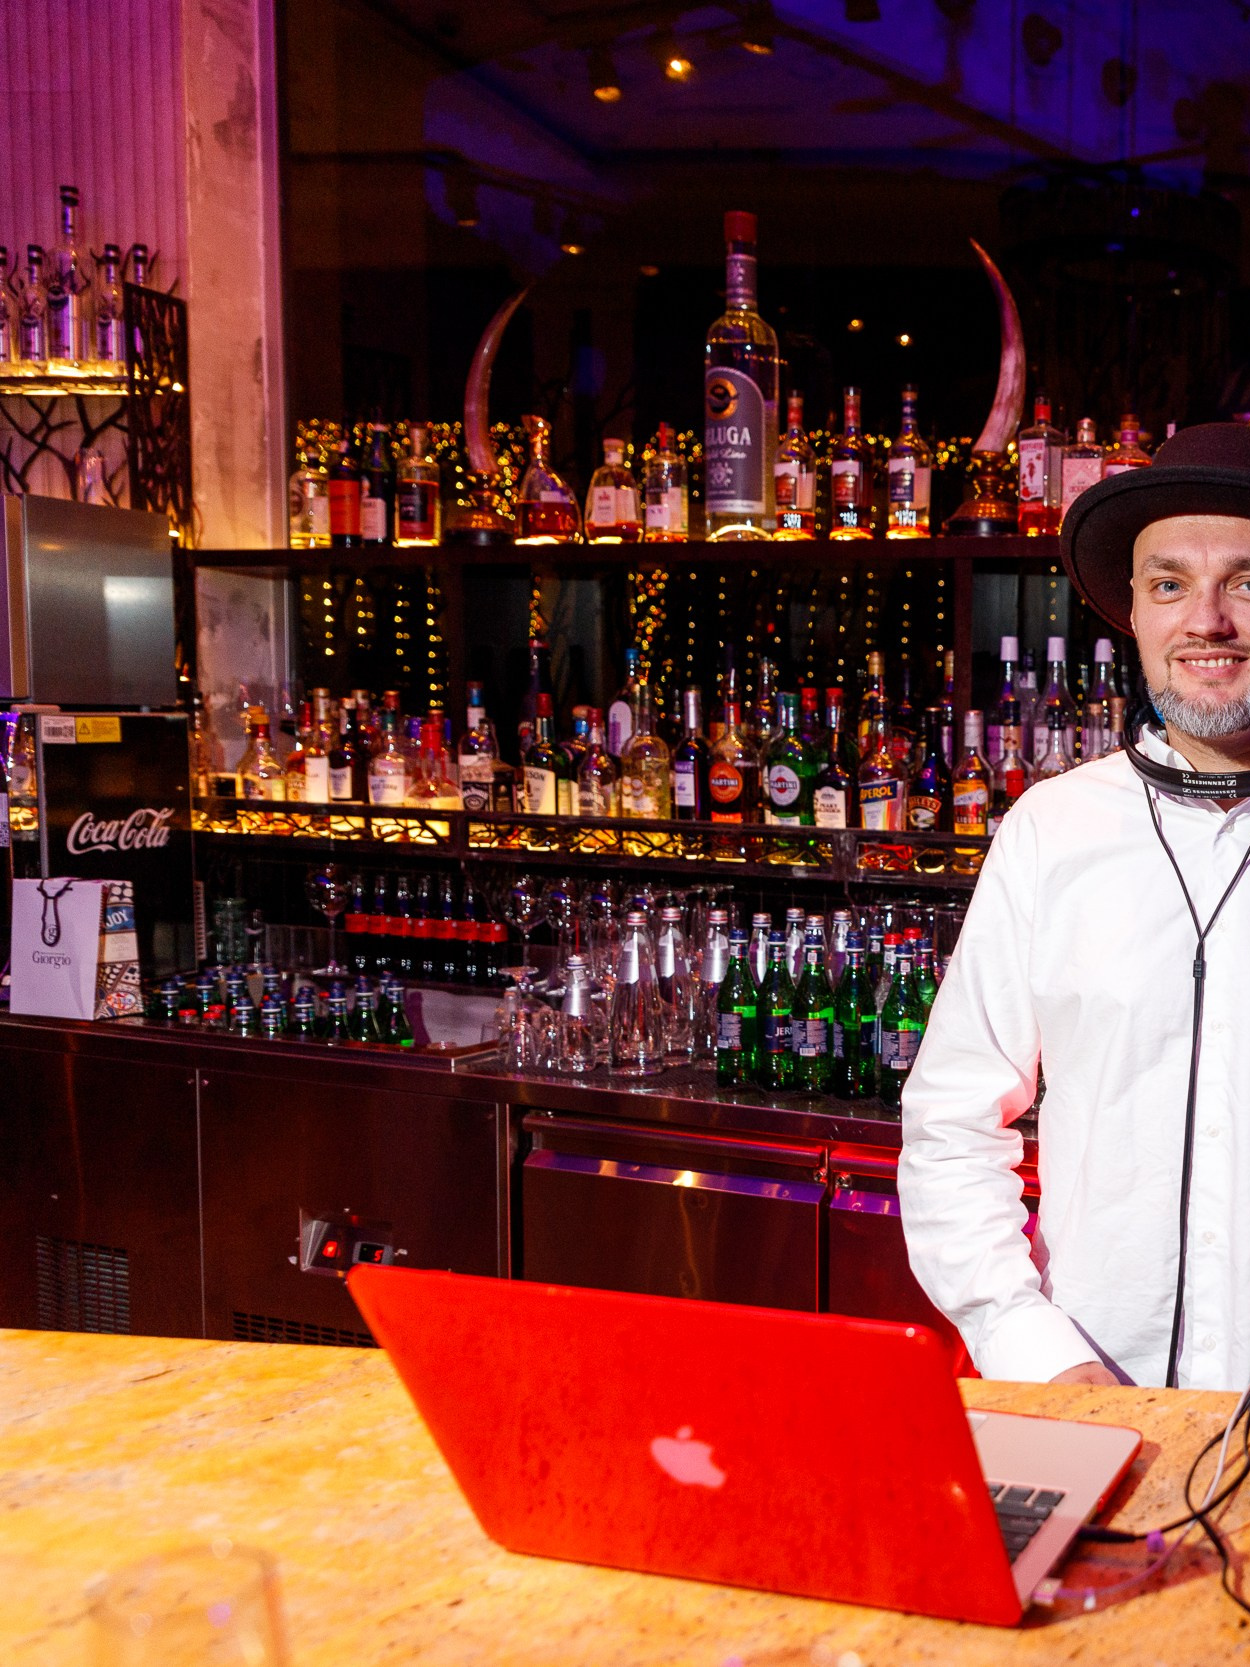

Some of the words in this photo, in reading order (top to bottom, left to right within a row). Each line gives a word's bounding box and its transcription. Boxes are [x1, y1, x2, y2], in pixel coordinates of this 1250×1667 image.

[711, 779, 738, 787] MARTINI
[770, 781, 797, 790] MARTINI
[861, 786, 892, 801] APEROL
[66, 807, 175, 855] Coca-Cola
[106, 909, 129, 927] JOY
[32, 950, 71, 969] Giorgio
